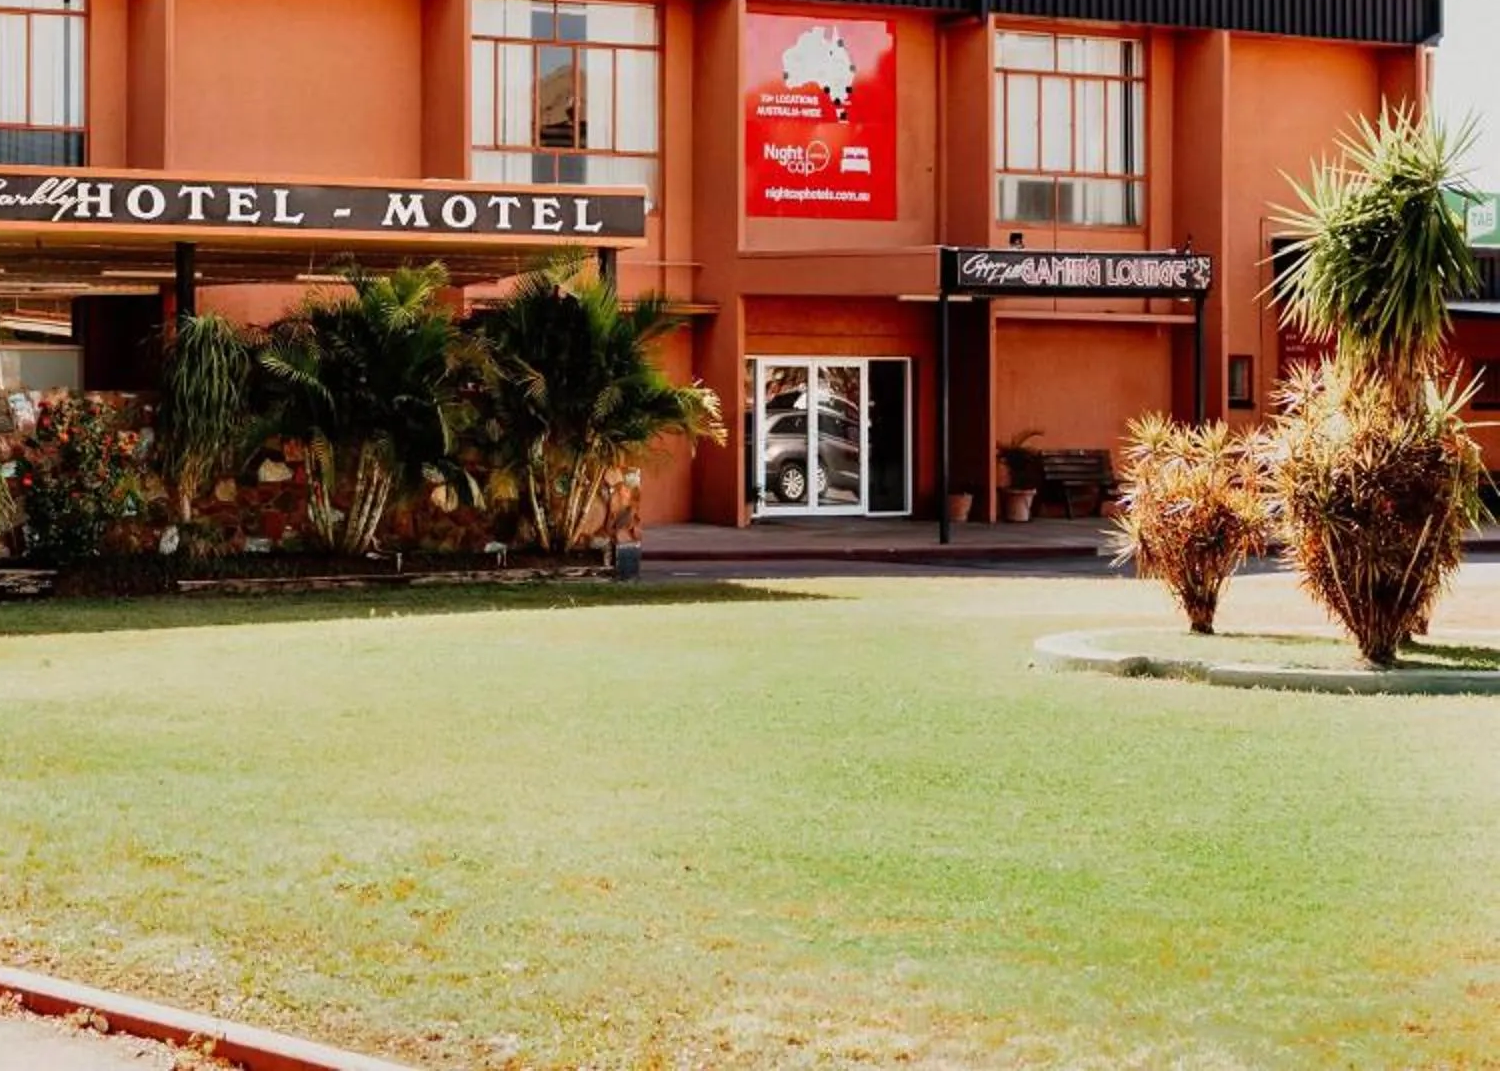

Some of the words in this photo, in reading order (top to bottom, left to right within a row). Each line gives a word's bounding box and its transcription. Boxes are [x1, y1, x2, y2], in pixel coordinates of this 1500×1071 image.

[764, 143, 804, 166] Night
[787, 160, 815, 177] cap
[74, 182, 304, 224] HOTEL
[381, 193, 603, 233] MOTEL
[1020, 256, 1101, 287] GAMING
[1105, 258, 1187, 288] LOUNGE
